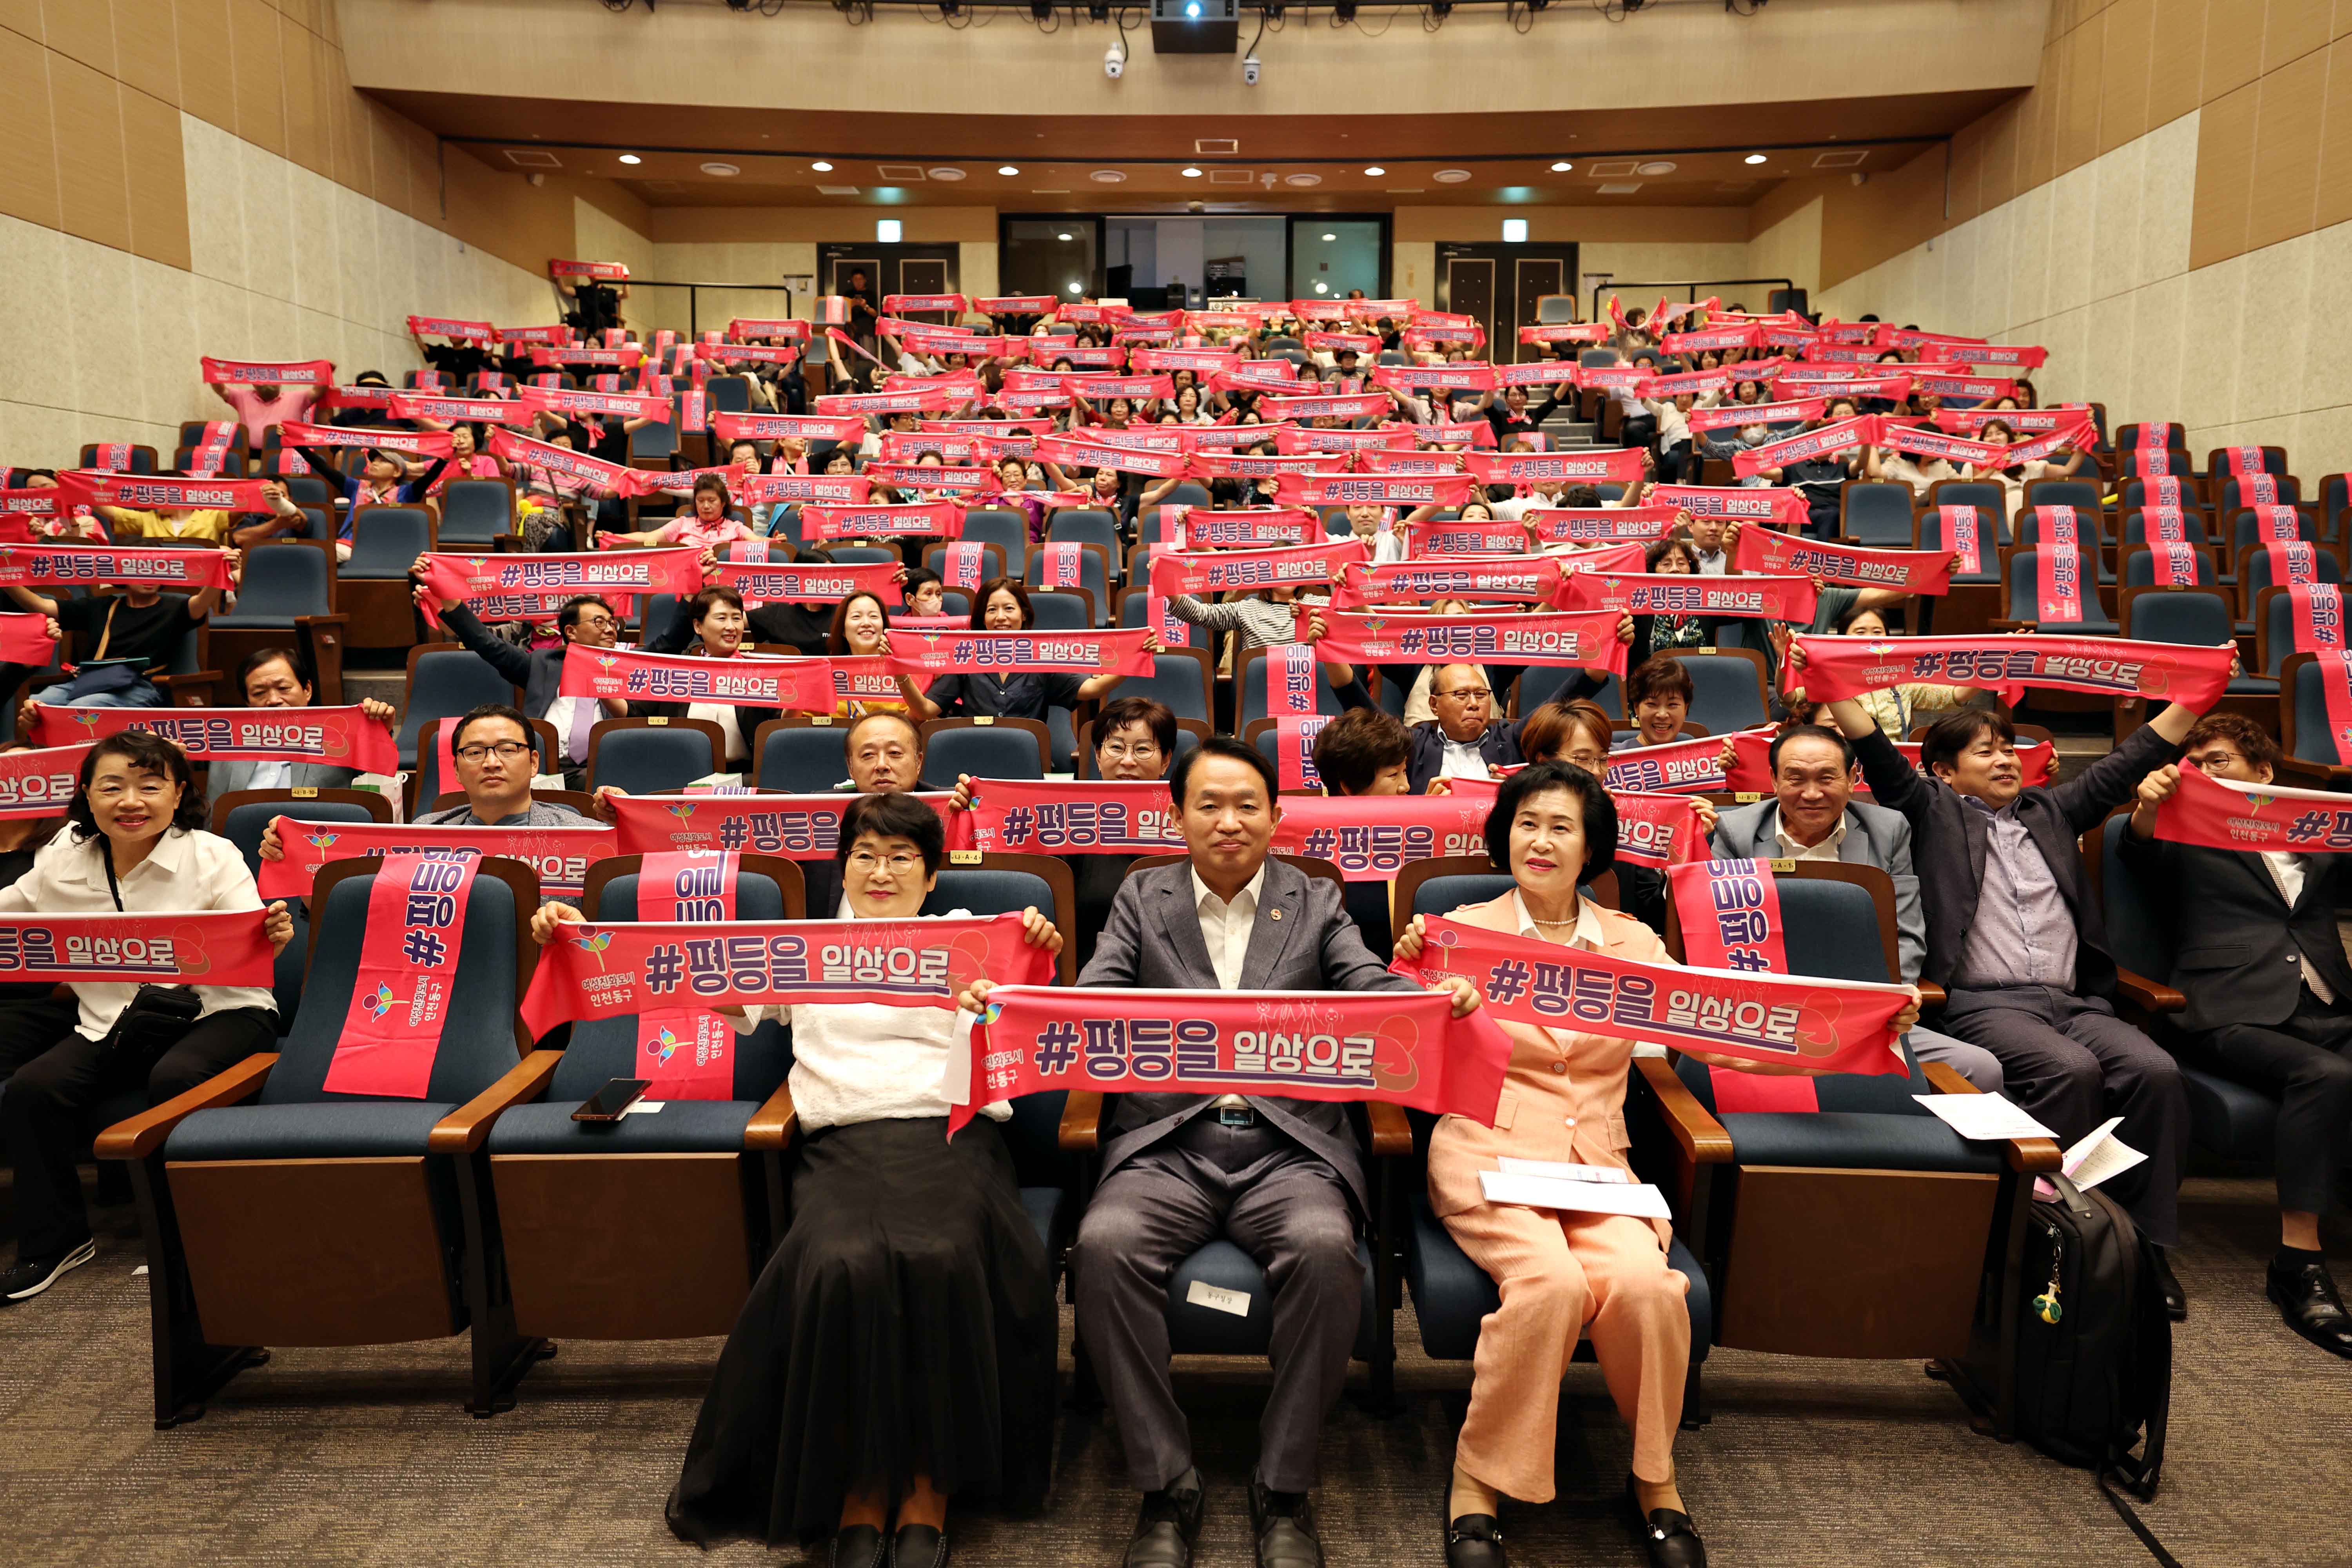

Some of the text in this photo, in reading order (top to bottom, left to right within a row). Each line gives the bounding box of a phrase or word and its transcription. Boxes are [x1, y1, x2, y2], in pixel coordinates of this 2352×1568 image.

[905, 298, 953, 309] #평등을 일상으로
[429, 323, 489, 337] #평등을 일상으로
[747, 324, 797, 335] #평등을 일상으로
[1425, 330, 1475, 341] #평등을 일상으로
[1543, 327, 1591, 338] #평등을 일상으로
[1162, 356, 1223, 368] #평등을 일상으로
[234, 368, 314, 381] #평등을 일상으로
[1403, 373, 1470, 386] #평등을 일상으로
[1506, 368, 1571, 382] #평등을 일상으로
[1663, 376, 1726, 392] #평등을 일상으로
[1087, 383, 1151, 394] #평등을 일상으로
[1808, 382, 1880, 396] #평등을 일상으로
[1923, 380, 1995, 396] #평등을 일상으로
[423, 403, 467, 416] #평등을
[470, 405, 504, 419] 일상으로
[563, 396, 605, 409] #평등을
[608, 399, 641, 411] 일상으로
[850, 397, 920, 410] #평등을 일상으로
[1007, 395, 1042, 407] #평등을
[1292, 400, 1363, 414] #평등을 일상으로
[1722, 406, 1800, 423] #평등을 일상으로
[2021, 417, 2056, 428] 일상으로
[756, 421, 798, 434] #평등을
[801, 423, 834, 434] 일상으로
[1197, 431, 1269, 446] #평등을 일상으로
[1444, 429, 1473, 442] 일상으로
[379, 437, 419, 449] 일상으로
[901, 441, 942, 457] #평등을
[1147, 437, 1178, 449] 일상으로
[1311, 436, 1387, 450] #평등을 일상으로
[1774, 429, 1857, 463] #평등을 일상으로
[1900, 435, 1988, 461] #평등을 일상으로
[528, 447, 610, 483] #평등을 일상으로
[1076, 447, 1123, 466] #평등을
[1124, 455, 1161, 471] 일상으로
[1229, 459, 1277, 473] #평등을
[1279, 461, 1317, 474] 일상으로
[1510, 459, 1564, 481] #평등을
[1566, 460, 1608, 475] 일상으로
[894, 467, 942, 485] #평등을
[944, 471, 981, 486] 일상으로
[118, 485, 234, 505] #평등을 일상으로
[764, 481, 811, 501] #평등을
[814, 483, 851, 500] 일상으로
[1325, 481, 1434, 504] #평등을 일상으로
[7, 497, 53, 512] 일상으로
[1666, 495, 1773, 517] #평등을 일상으로
[841, 514, 931, 532] #평등을 일상으로
[1195, 521, 1302, 542] #평등을 일상으로
[1553, 518, 1662, 539] #평등을 일상으로
[1953, 506, 1975, 553] #평등을
[1428, 531, 1524, 553] #평등을 일상으로
[30, 554, 185, 579] #평등을 일상으로
[958, 542, 981, 589] #평등을
[1208, 559, 1327, 586] #평등을 일상으로
[1788, 550, 1910, 583] #평등을 일상으로
[2053, 544, 2076, 597] #평등을
[2166, 542, 2193, 586] #평등을
[2281, 542, 2311, 584] #평등을
[500, 561, 650, 588] #평등을 일상으로
[734, 574, 856, 597] #평등을 일상으로
[1392, 571, 1538, 594] #평등을 일상으로
[1362, 590, 1384, 598] 인천동구
[1630, 584, 1763, 611] #평등을 일상으로
[2307, 583, 2338, 644] #평등을
[953, 638, 1100, 666] #평등을 일상으로
[1400, 625, 1579, 657] #평등을 일상으로
[1365, 648, 1391, 657] 인천동구
[1286, 646, 1312, 711] #평등을
[1912, 649, 2144, 686] #평등을 일상으로
[627, 668, 779, 697] #평등을 일상으로
[1866, 673, 1898, 685] 인천동구
[240, 723, 324, 749] 일상으로
[1603, 759, 1662, 791] 평등을
[0, 774, 74, 804] 상으로
[719, 811, 839, 852] #평등을
[1002, 802, 1128, 847] #평등을
[2230, 829, 2268, 842] 인천동구
[670, 832, 712, 842] 여성친화도시
[1302, 825, 1434, 872] #평등을
[403, 853, 473, 968] #평등을
[1705, 858, 1771, 973] #평등을
[0, 927, 175, 971] 등을 일상으로
[645, 935, 950, 996] #평등을 일상으로
[581, 971, 636, 992] 여성친화도시
[409, 975, 430, 1027] 여성친화도시
[424, 982, 443, 1022] 인천동구
[590, 988, 633, 1007] 인천동구
[1486, 958, 1800, 1045] #평등을 일상으로
[696, 1014, 710, 1067] 여성친화도시
[711, 1019, 723, 1060] 인천동구
[1034, 1018, 1376, 1081] #평등을 일상으로
[982, 1048, 1024, 1071] 친화도시
